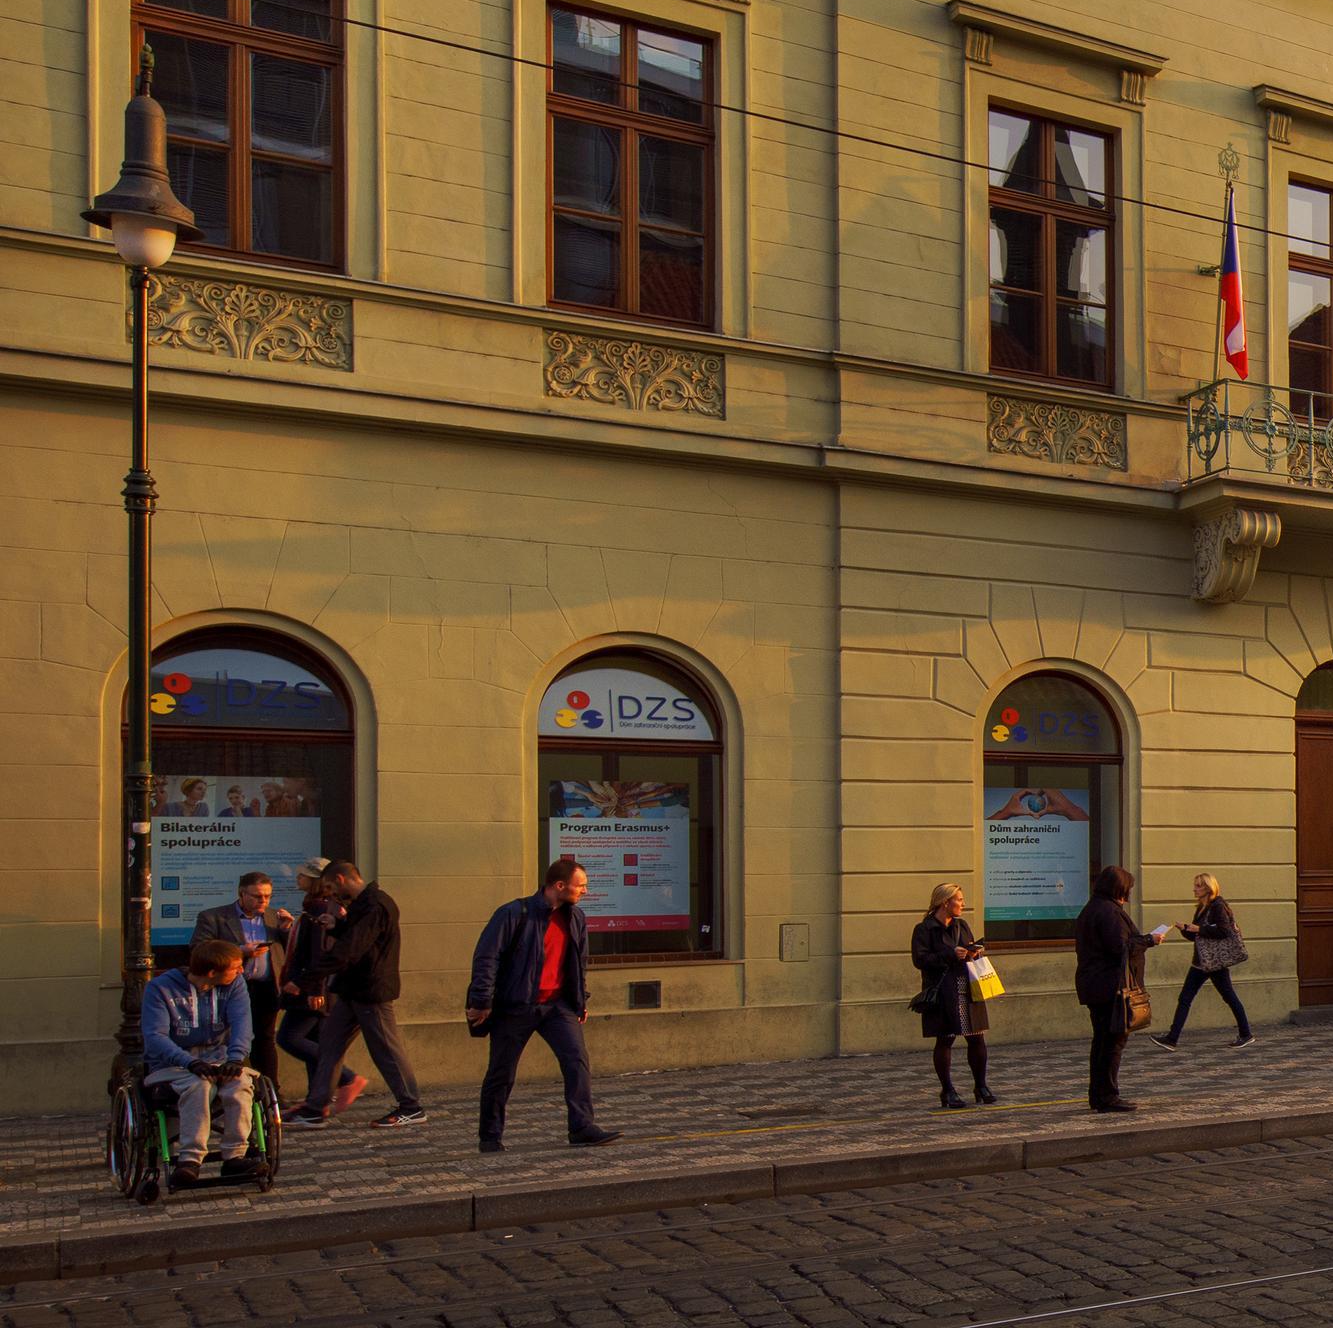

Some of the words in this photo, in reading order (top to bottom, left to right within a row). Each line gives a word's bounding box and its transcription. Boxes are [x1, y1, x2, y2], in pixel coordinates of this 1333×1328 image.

[227, 678, 322, 708] DZS
[618, 695, 695, 722] DZS
[1040, 712, 1100, 737] DZS
[161, 823, 236, 833] Bilaterální
[560, 823, 611, 833] Program
[614, 824, 671, 832] Erasmus+
[990, 824, 1011, 832] Dům
[161, 837, 241, 849] spolupráce
[990, 836, 1040, 845] spolupráce
